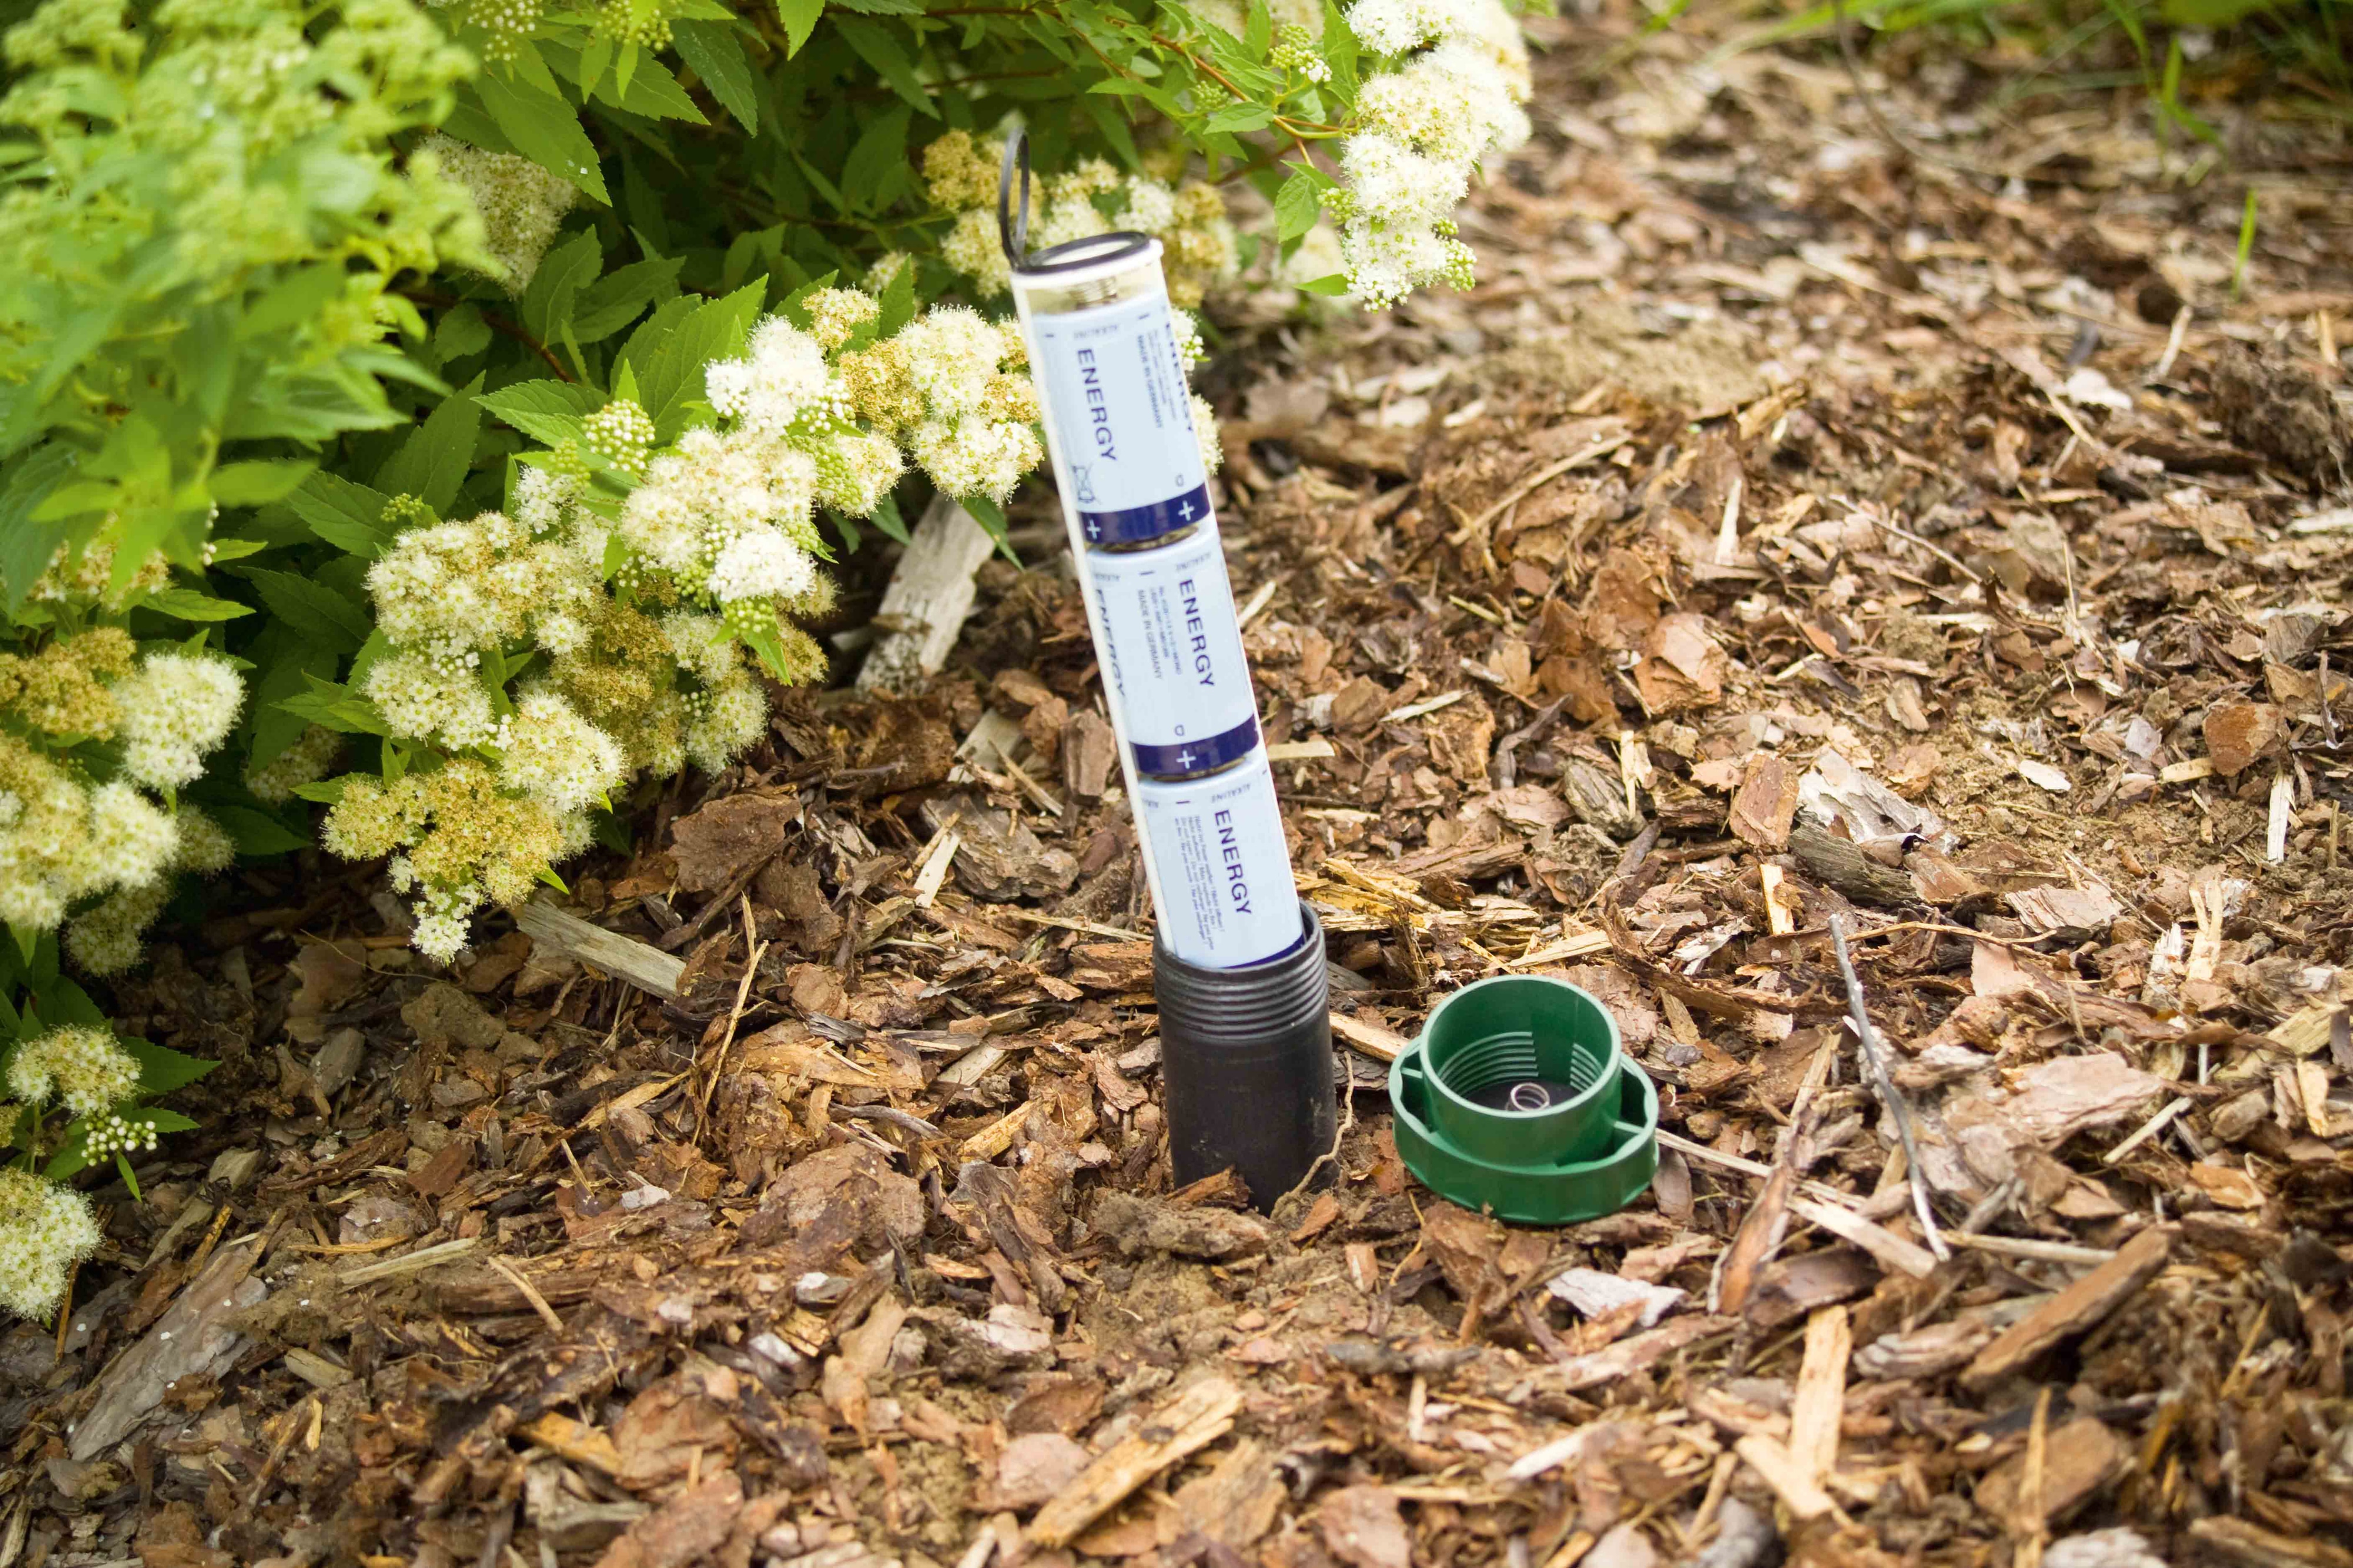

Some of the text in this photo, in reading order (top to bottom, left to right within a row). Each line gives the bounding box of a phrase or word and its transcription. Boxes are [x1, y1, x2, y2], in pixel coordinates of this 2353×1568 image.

[1077, 348, 1118, 462] ENERGY
[1179, 579, 1215, 687] ENERGY
[1214, 809, 1252, 915] ENERGY
